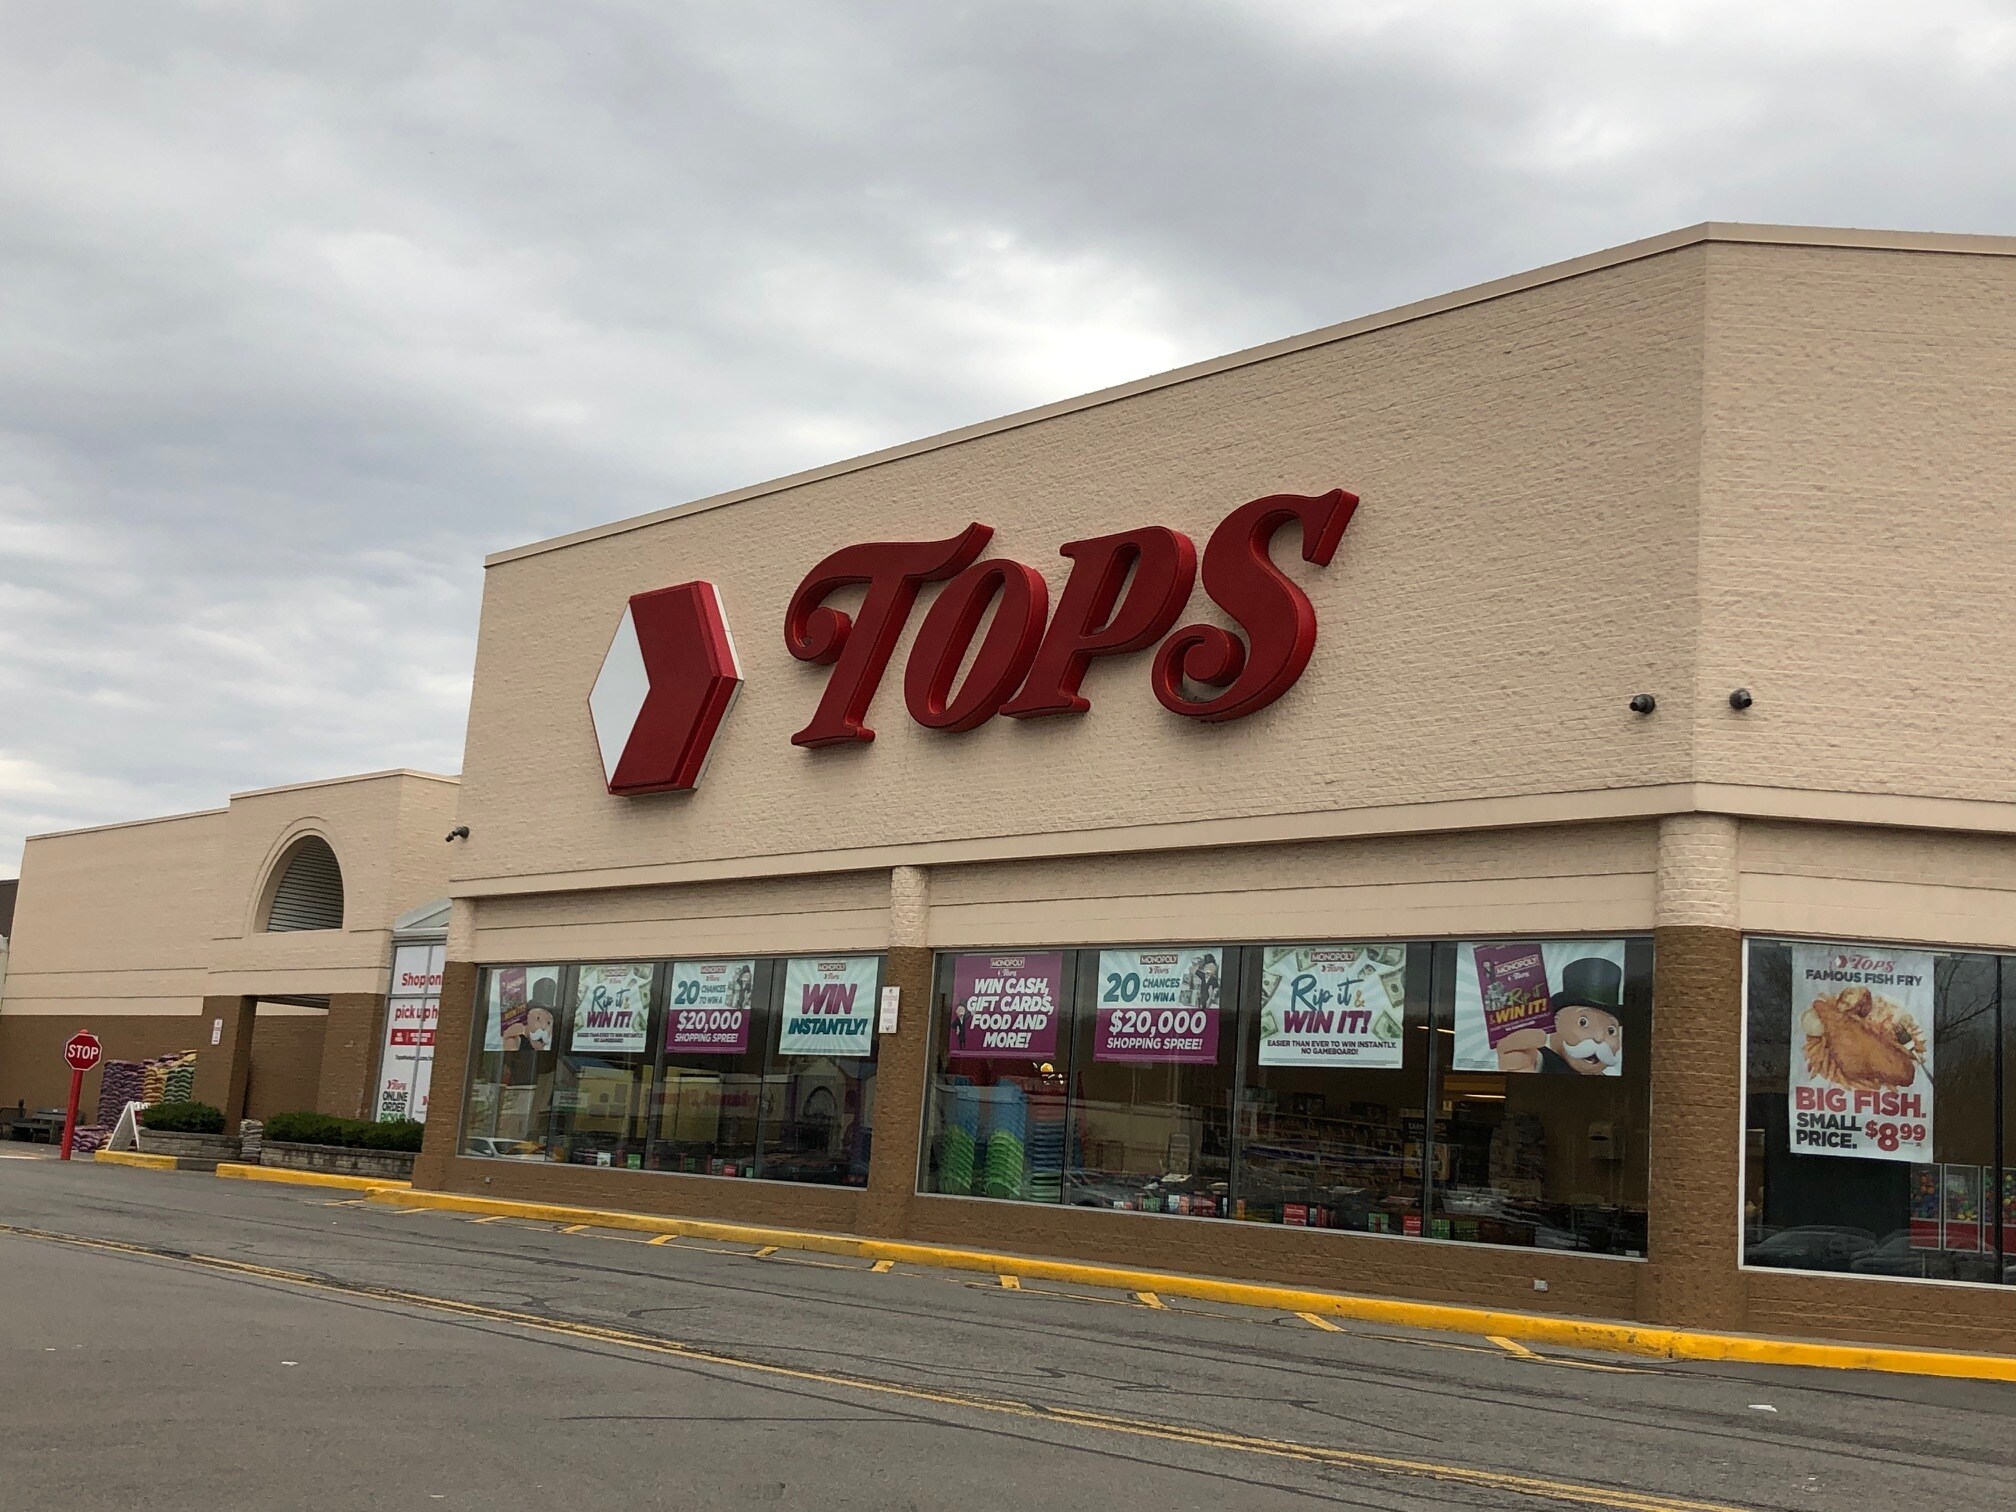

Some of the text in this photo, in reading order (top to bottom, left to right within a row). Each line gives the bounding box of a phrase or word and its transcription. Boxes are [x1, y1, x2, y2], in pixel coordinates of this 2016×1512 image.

[784, 488, 1360, 749] TOPS
[991, 958, 1023, 967] MONOPOLY
[1141, 955, 1177, 964] MONOPOLY
[1312, 952, 1354, 961] MONOPOLY
[1497, 957, 1536, 975] MONOPOLY
[402, 973, 426, 988] Shop
[1143, 978, 1180, 988] CHANCES
[1806, 969, 1923, 986] FAMOUS FISH FRY
[674, 980, 700, 1005] 20
[975, 978, 1049, 996] WIN CASH,
[1103, 972, 1140, 1003] 20
[1291, 974, 1365, 1012] Rip it &
[802, 983, 858, 1014] WIN
[967, 996, 1054, 1015] GIFT CARDS,
[1140, 993, 1175, 1002] TO WIN A
[395, 1005, 415, 1021] pick
[1496, 1004, 1525, 1023] WIN
[1528, 998, 1548, 1014] IT!
[587, 1011, 633, 1028] WIN IT!
[677, 1011, 742, 1033] $20,000
[788, 1018, 868, 1035] INSTANTLY!
[970, 1014, 1047, 1030] FOOD AND
[1109, 1010, 1206, 1037] $20,000
[1284, 1011, 1372, 1033] WIN IT!
[674, 1033, 738, 1042] SHOPPING SPREE!
[983, 1032, 1031, 1048] MORE!
[1107, 1037, 1203, 1049] SHOPPING SPREE!
[68, 1044, 98, 1059] STOP
[382, 1091, 408, 1102] ONLINE
[1796, 1086, 1926, 1118] BIG FISH.
[382, 1102, 405, 1112] ORDER
[1797, 1112, 1862, 1131] SMALL
[1796, 1129, 1857, 1149] PRICE.
